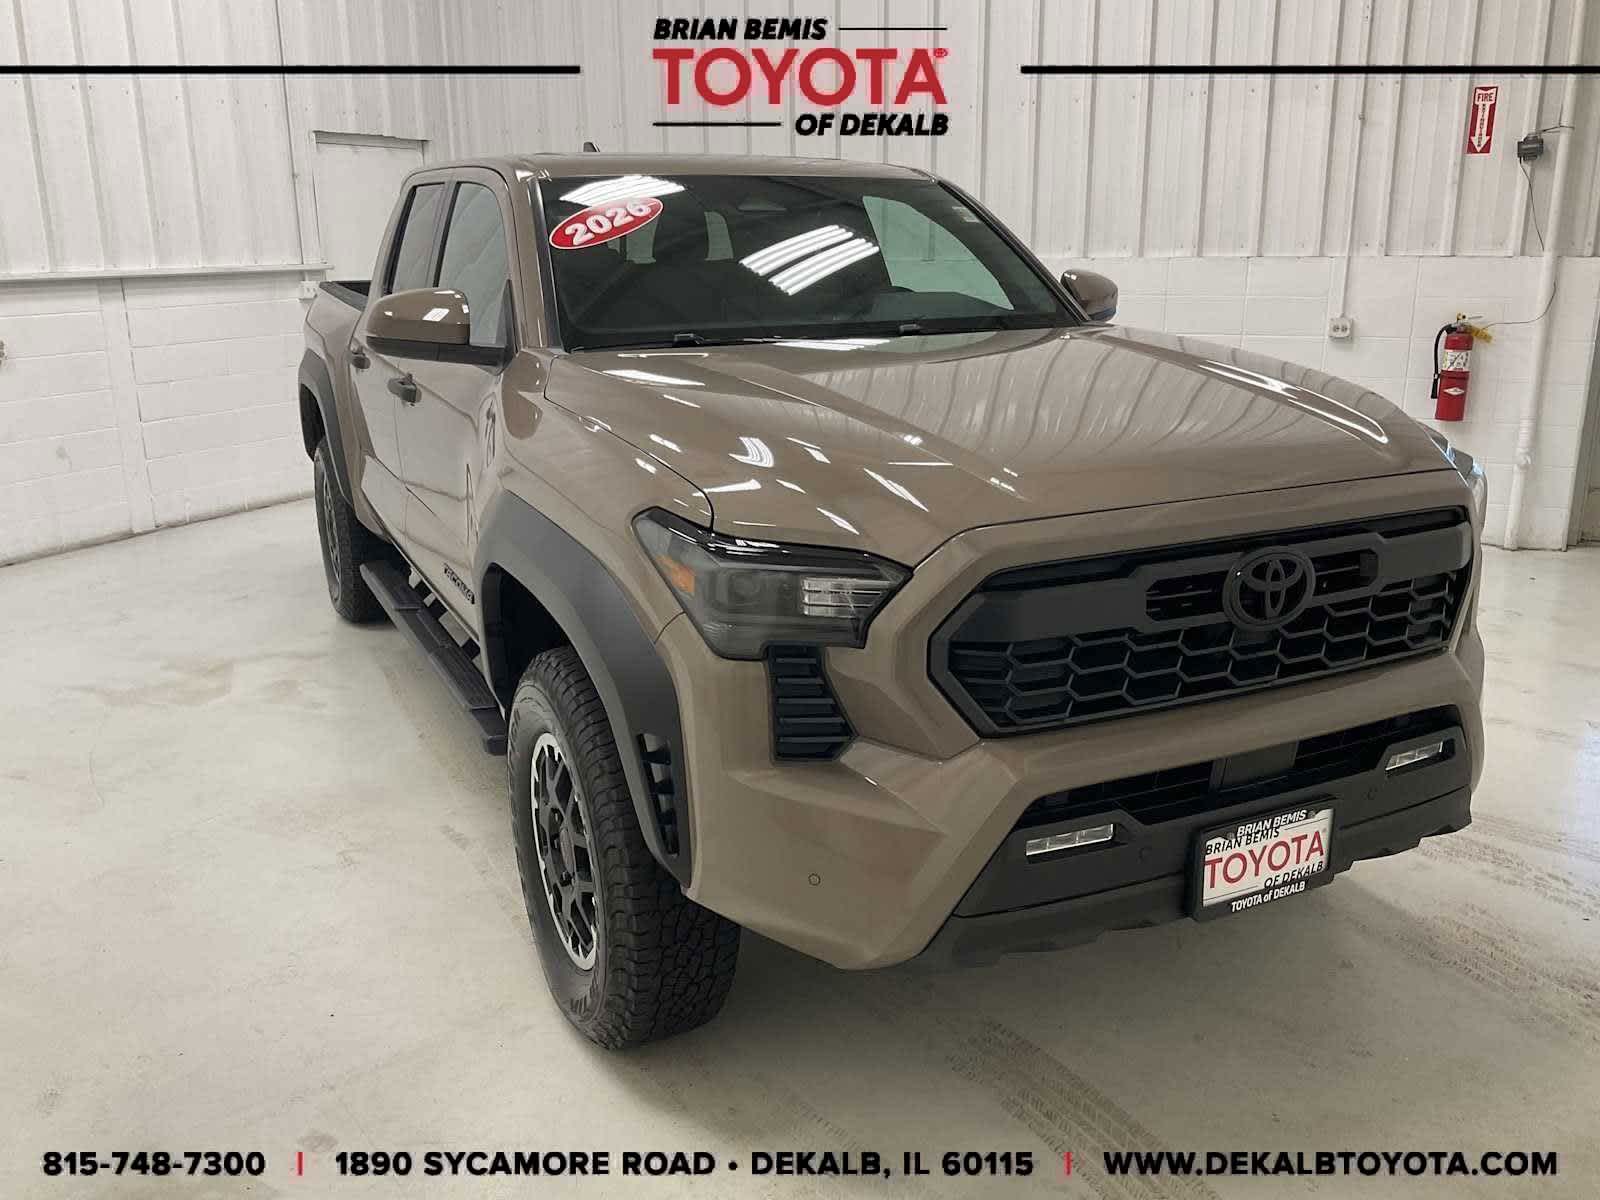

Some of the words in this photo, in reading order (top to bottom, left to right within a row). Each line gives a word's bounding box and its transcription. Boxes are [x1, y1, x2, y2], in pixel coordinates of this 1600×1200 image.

[1477, 93, 1493, 102] FIRE
[564, 200, 652, 246] 2026
[1237, 819, 1271, 837] BRIAN
[1273, 810, 1307, 827] BEMIS
[1206, 836, 1242, 855] BRIAN
[1204, 830, 1325, 890] TOYOTA
[1264, 875, 1280, 889] OF
[1283, 861, 1323, 882] DEKALB
[1231, 894, 1262, 912] TOYOTA
[1263, 889, 1273, 902] of
[1273, 880, 1306, 900] DEKALB
